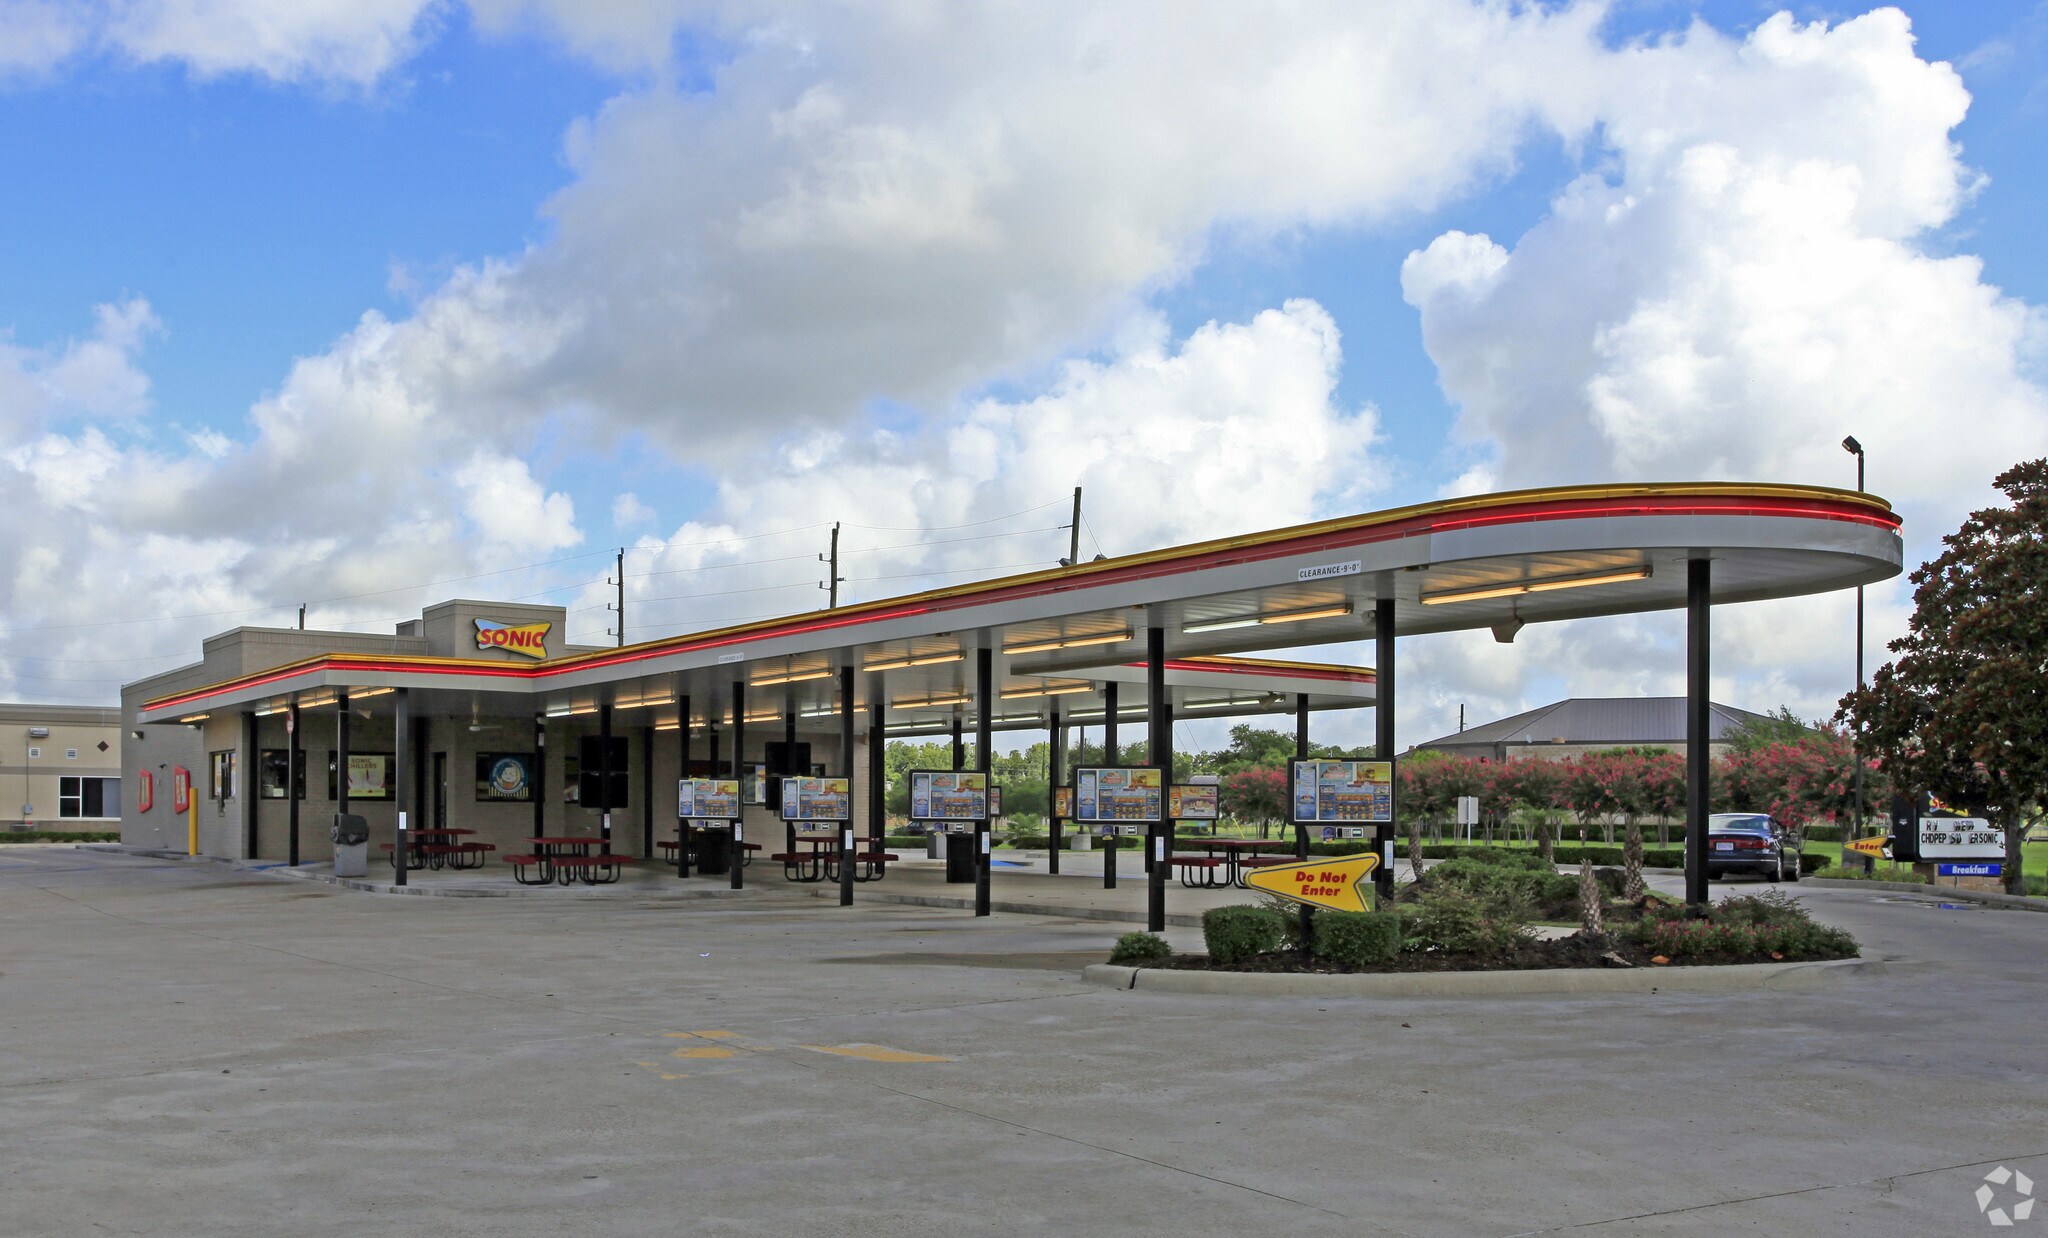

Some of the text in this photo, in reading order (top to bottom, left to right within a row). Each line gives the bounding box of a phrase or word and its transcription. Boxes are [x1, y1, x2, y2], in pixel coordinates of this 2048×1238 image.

[480, 628, 545, 648] SONIC
[1854, 842, 1878, 850] Enter
[1952, 864, 1989, 874] Breakfast
[1295, 871, 1347, 883] Do Not
[1301, 885, 1341, 896] Enter
